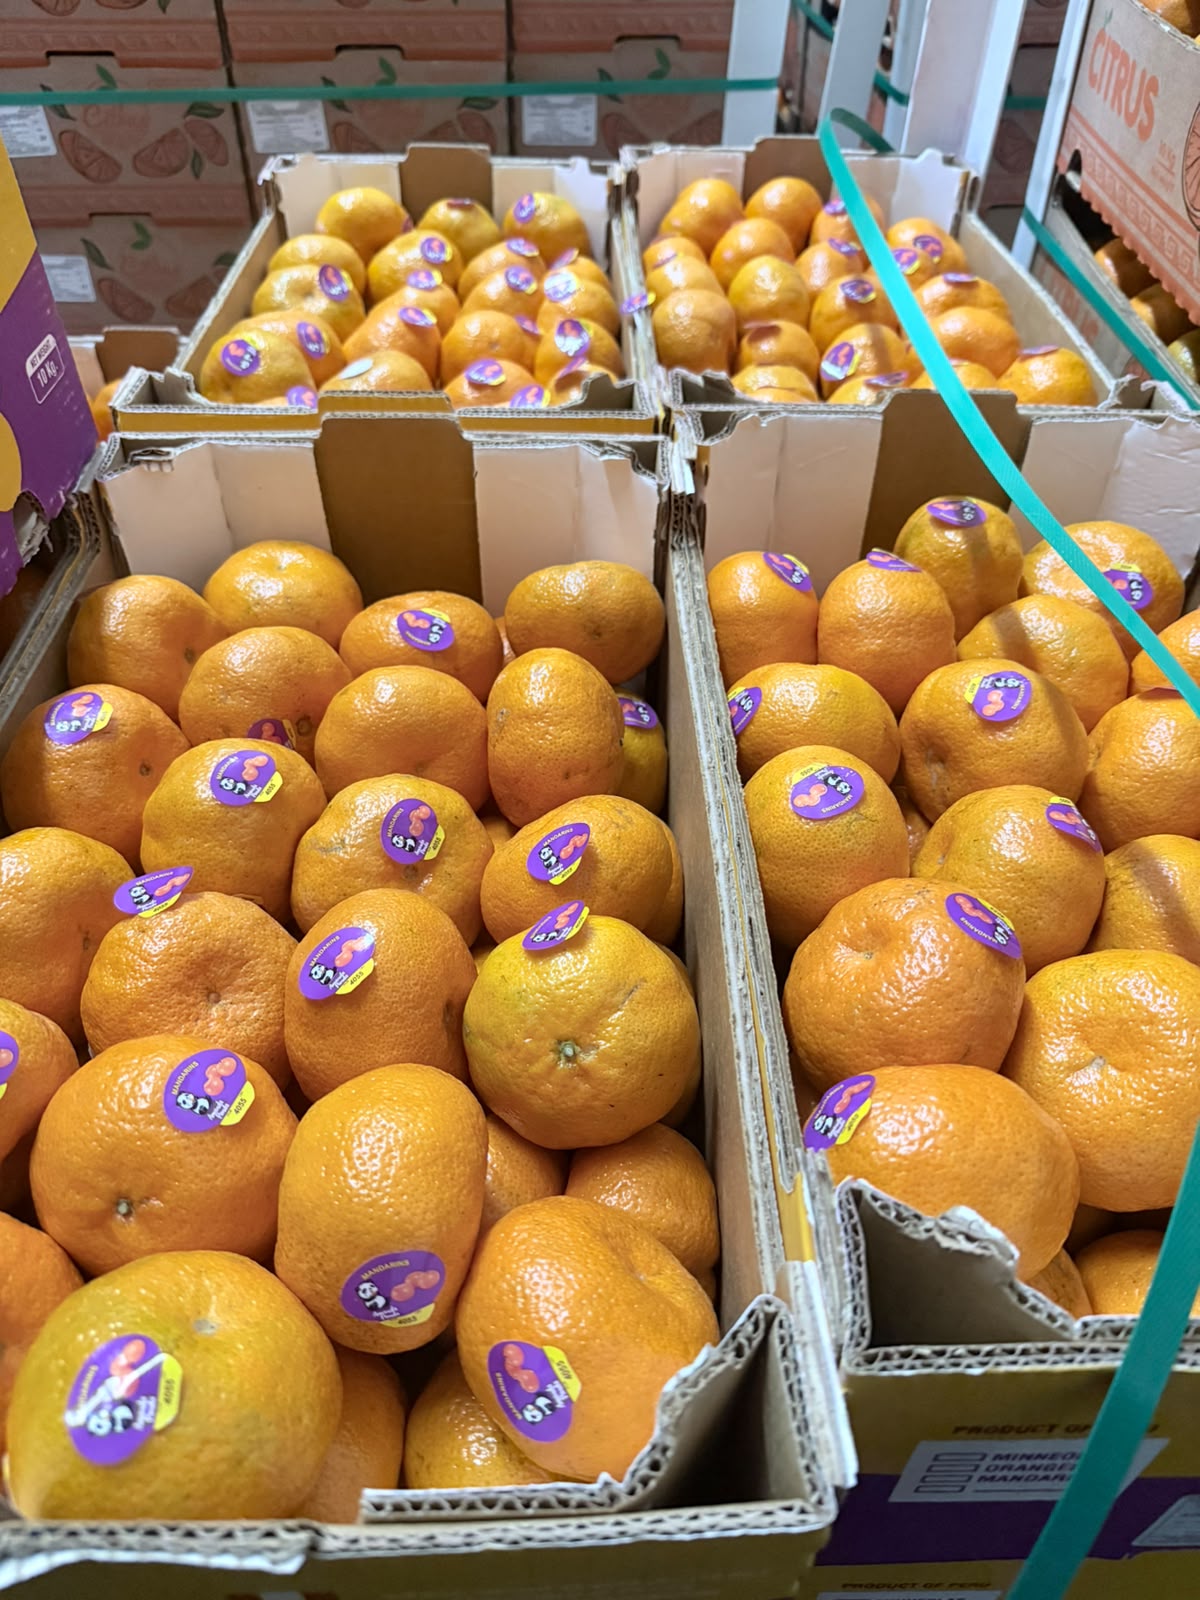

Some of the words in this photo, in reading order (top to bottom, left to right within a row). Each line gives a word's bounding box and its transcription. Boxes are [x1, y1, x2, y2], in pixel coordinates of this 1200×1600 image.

[1088, 27, 1159, 143] CITRUS
[37, 368, 48, 388] 10
[265, 783, 276, 796] 4055
[821, 794, 854, 814] MANDARINS
[386, 807, 405, 838] MANDARINS
[543, 828, 573, 847] MANDARINS
[135, 872, 174, 886] MANDARINS
[309, 935, 341, 967] MANDARINS
[349, 971, 364, 985] 4055
[171, 1061, 199, 1096] MANDARINS
[233, 1098, 247, 1115] 4055
[361, 1259, 410, 1280] MANDARINS
[495, 1372, 523, 1420] MANDARINS
[951, 1423, 1058, 1435] PRODUCT
[991, 1452, 1081, 1462] MINNEO
[976, 1474, 1072, 1483] MANDAR
[841, 1582, 915, 1590] PRODUCT
